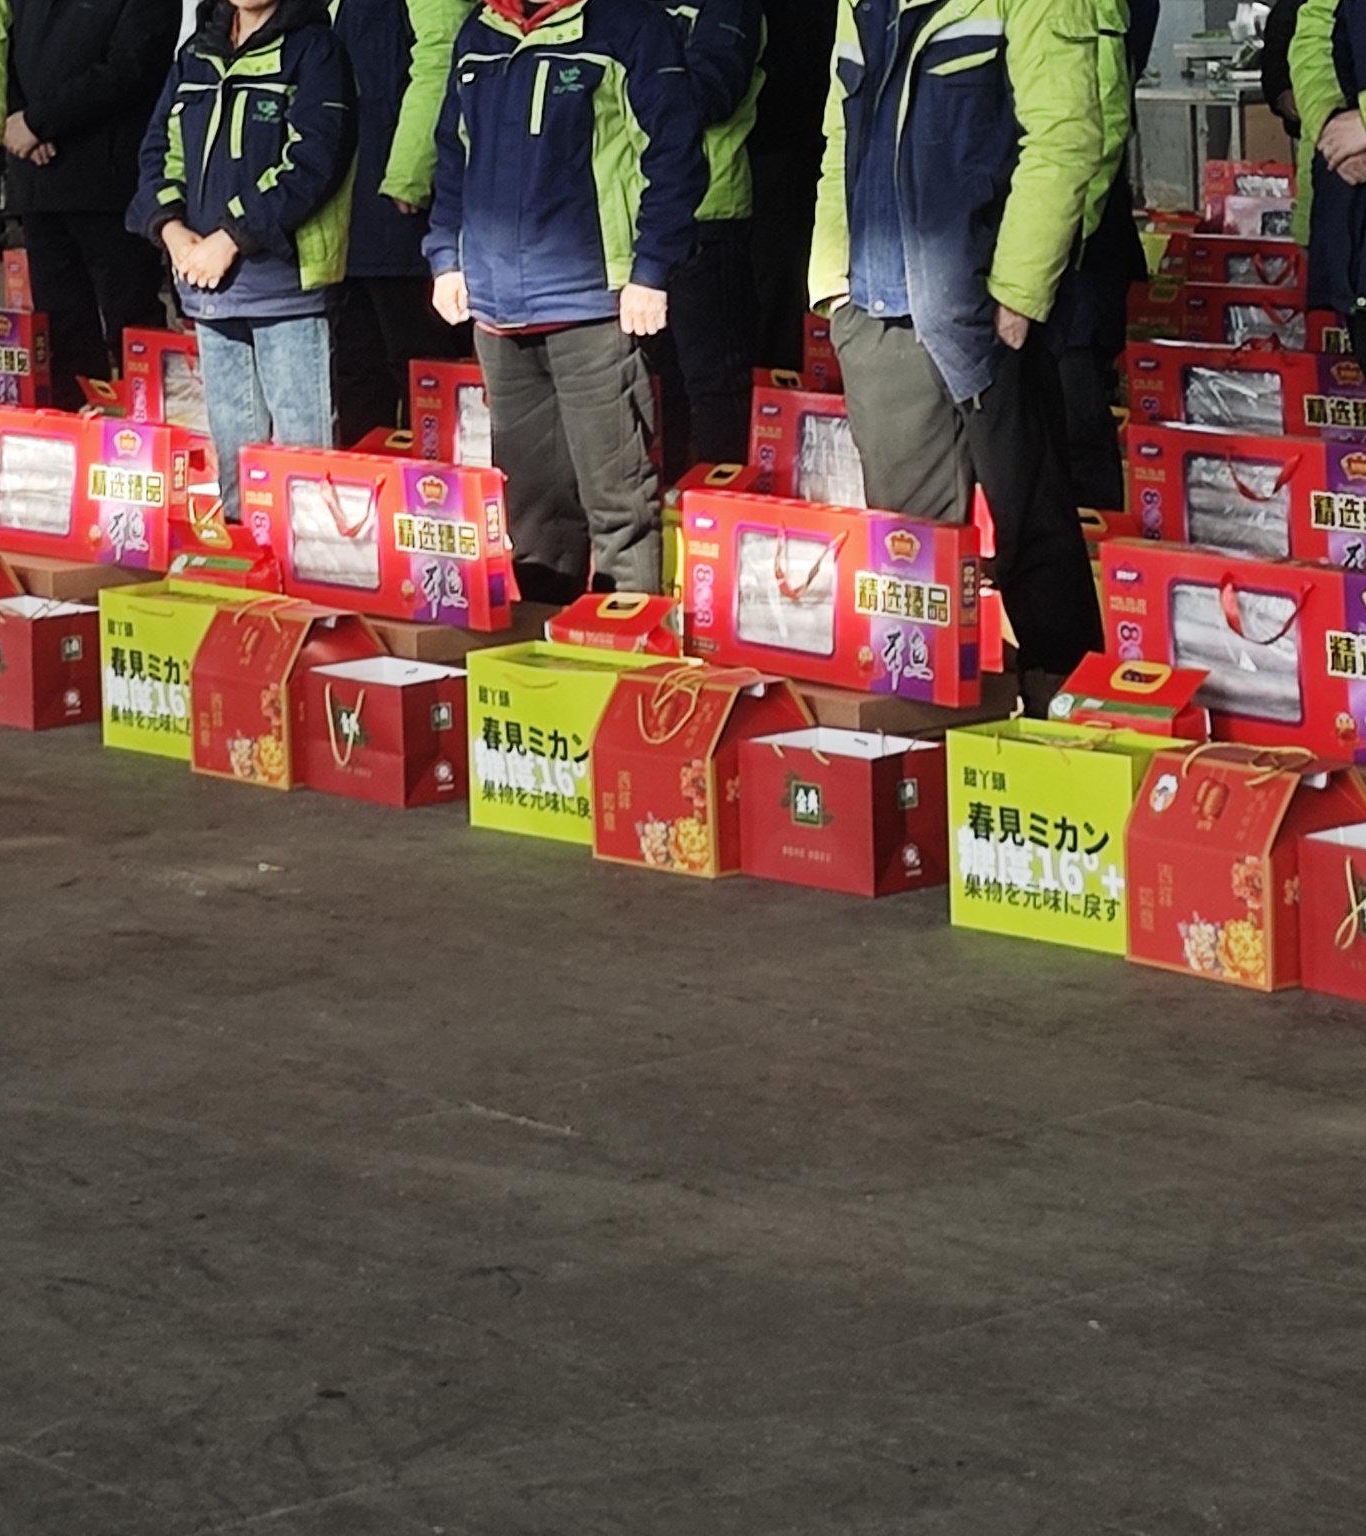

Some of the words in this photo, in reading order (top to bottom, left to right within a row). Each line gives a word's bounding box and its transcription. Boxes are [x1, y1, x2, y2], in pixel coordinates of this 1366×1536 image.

[88, 465, 164, 507] 精选臻品
[394, 513, 479, 560] 精选臻品
[854, 571, 951, 626] 精选臻品
[968, 801, 1110, 856] 春見ミカン
